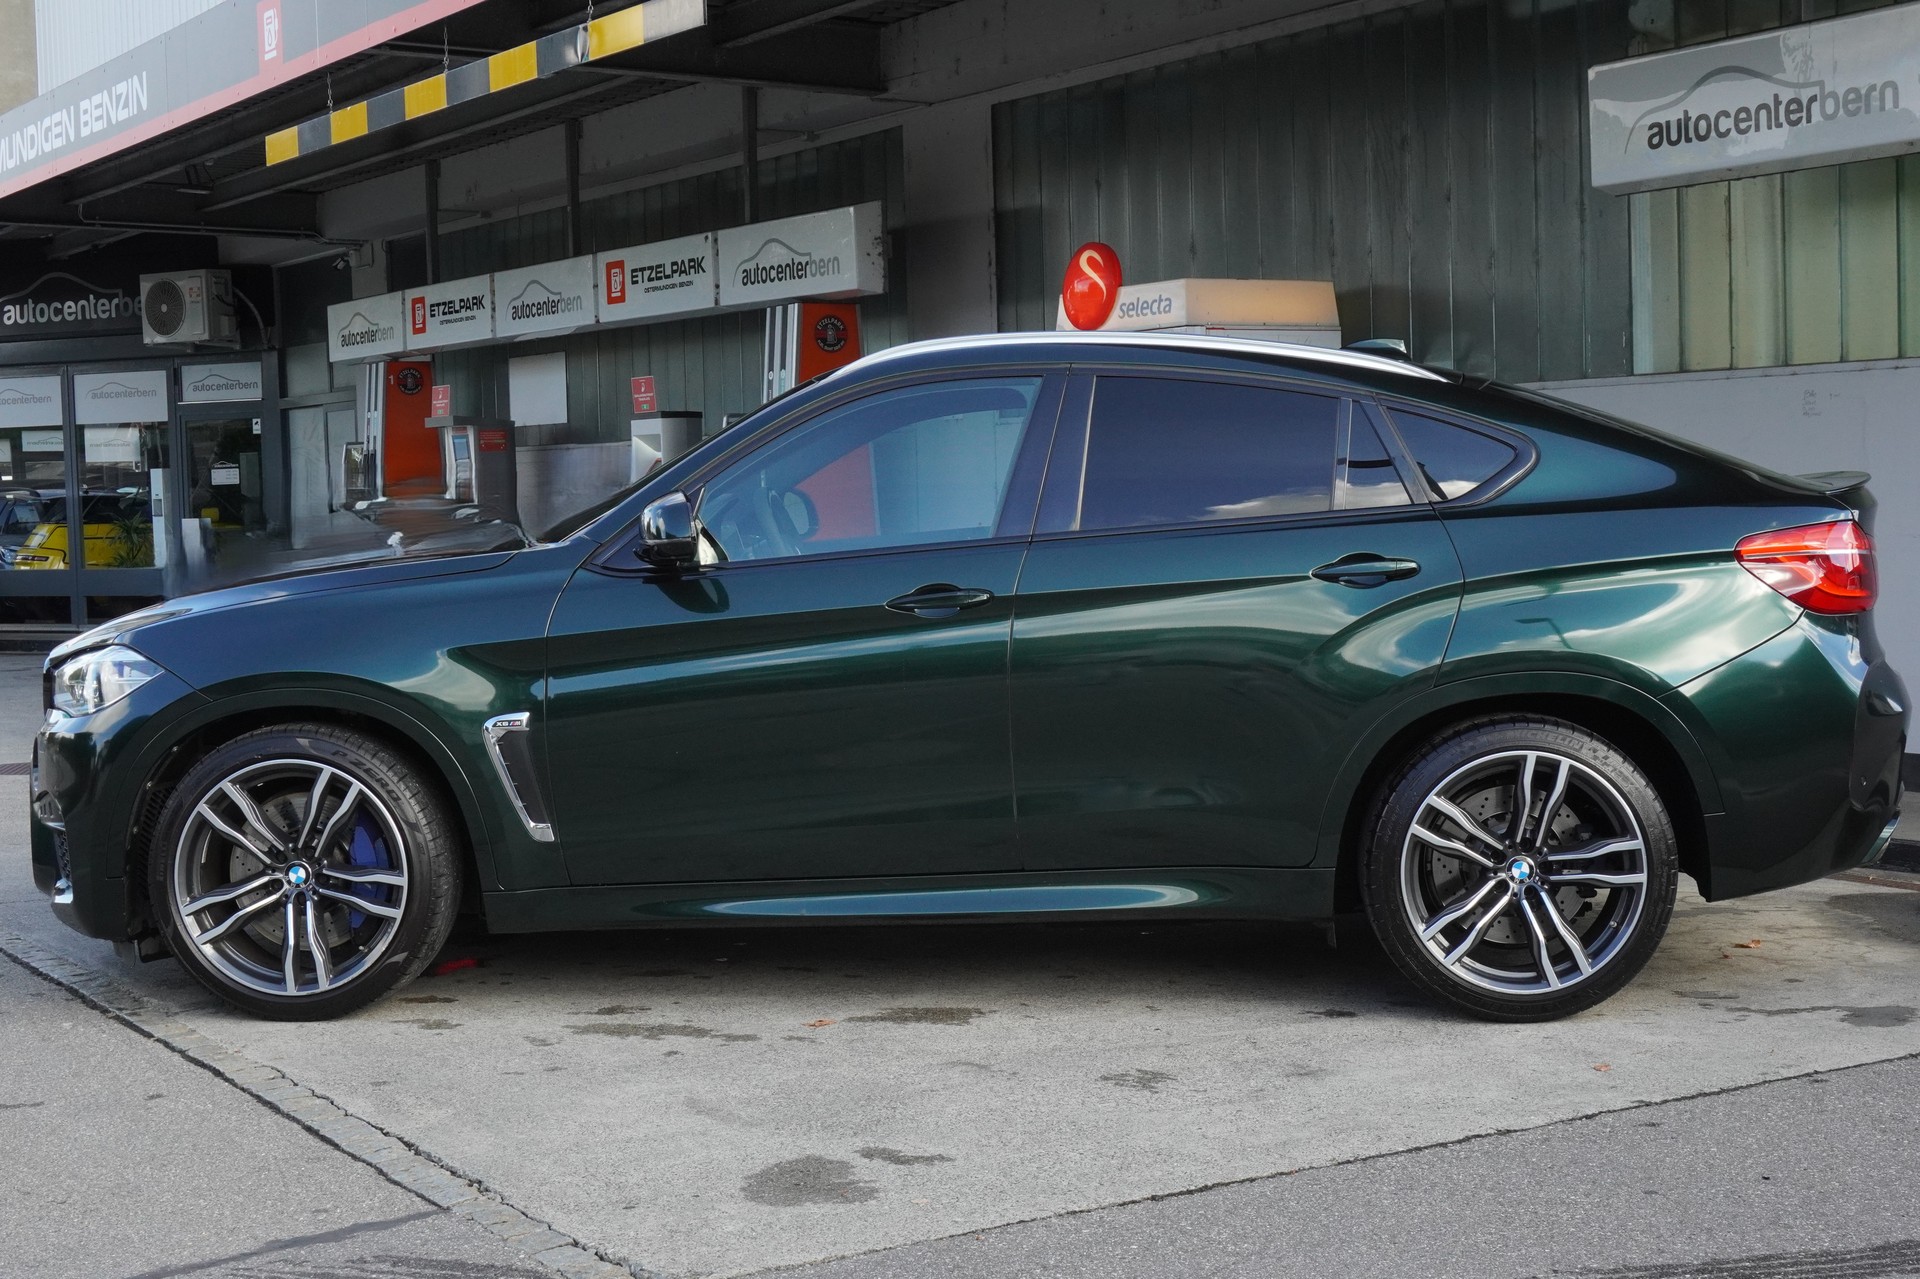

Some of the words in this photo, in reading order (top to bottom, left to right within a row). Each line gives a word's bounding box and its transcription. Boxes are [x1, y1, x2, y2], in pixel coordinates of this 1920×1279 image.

[79, 71, 148, 138] BENZIN
[1647, 80, 1899, 150] autocenterbern
[631, 256, 706, 285] ETZELPARK
[741, 253, 841, 287] autocenterbern
[678, 280, 694, 288] BENZIN
[429, 294, 485, 318] ETZELPARK
[511, 292, 583, 321] autocenterbern
[1118, 294, 1172, 319] selecta
[340, 324, 395, 348] autocenterbern
[817, 317, 844, 330] ETZELPARK
[91, 387, 157, 400] autocenterbern
[192, 380, 259, 392] autocenterbern
[349, 758, 402, 802] ZERO
